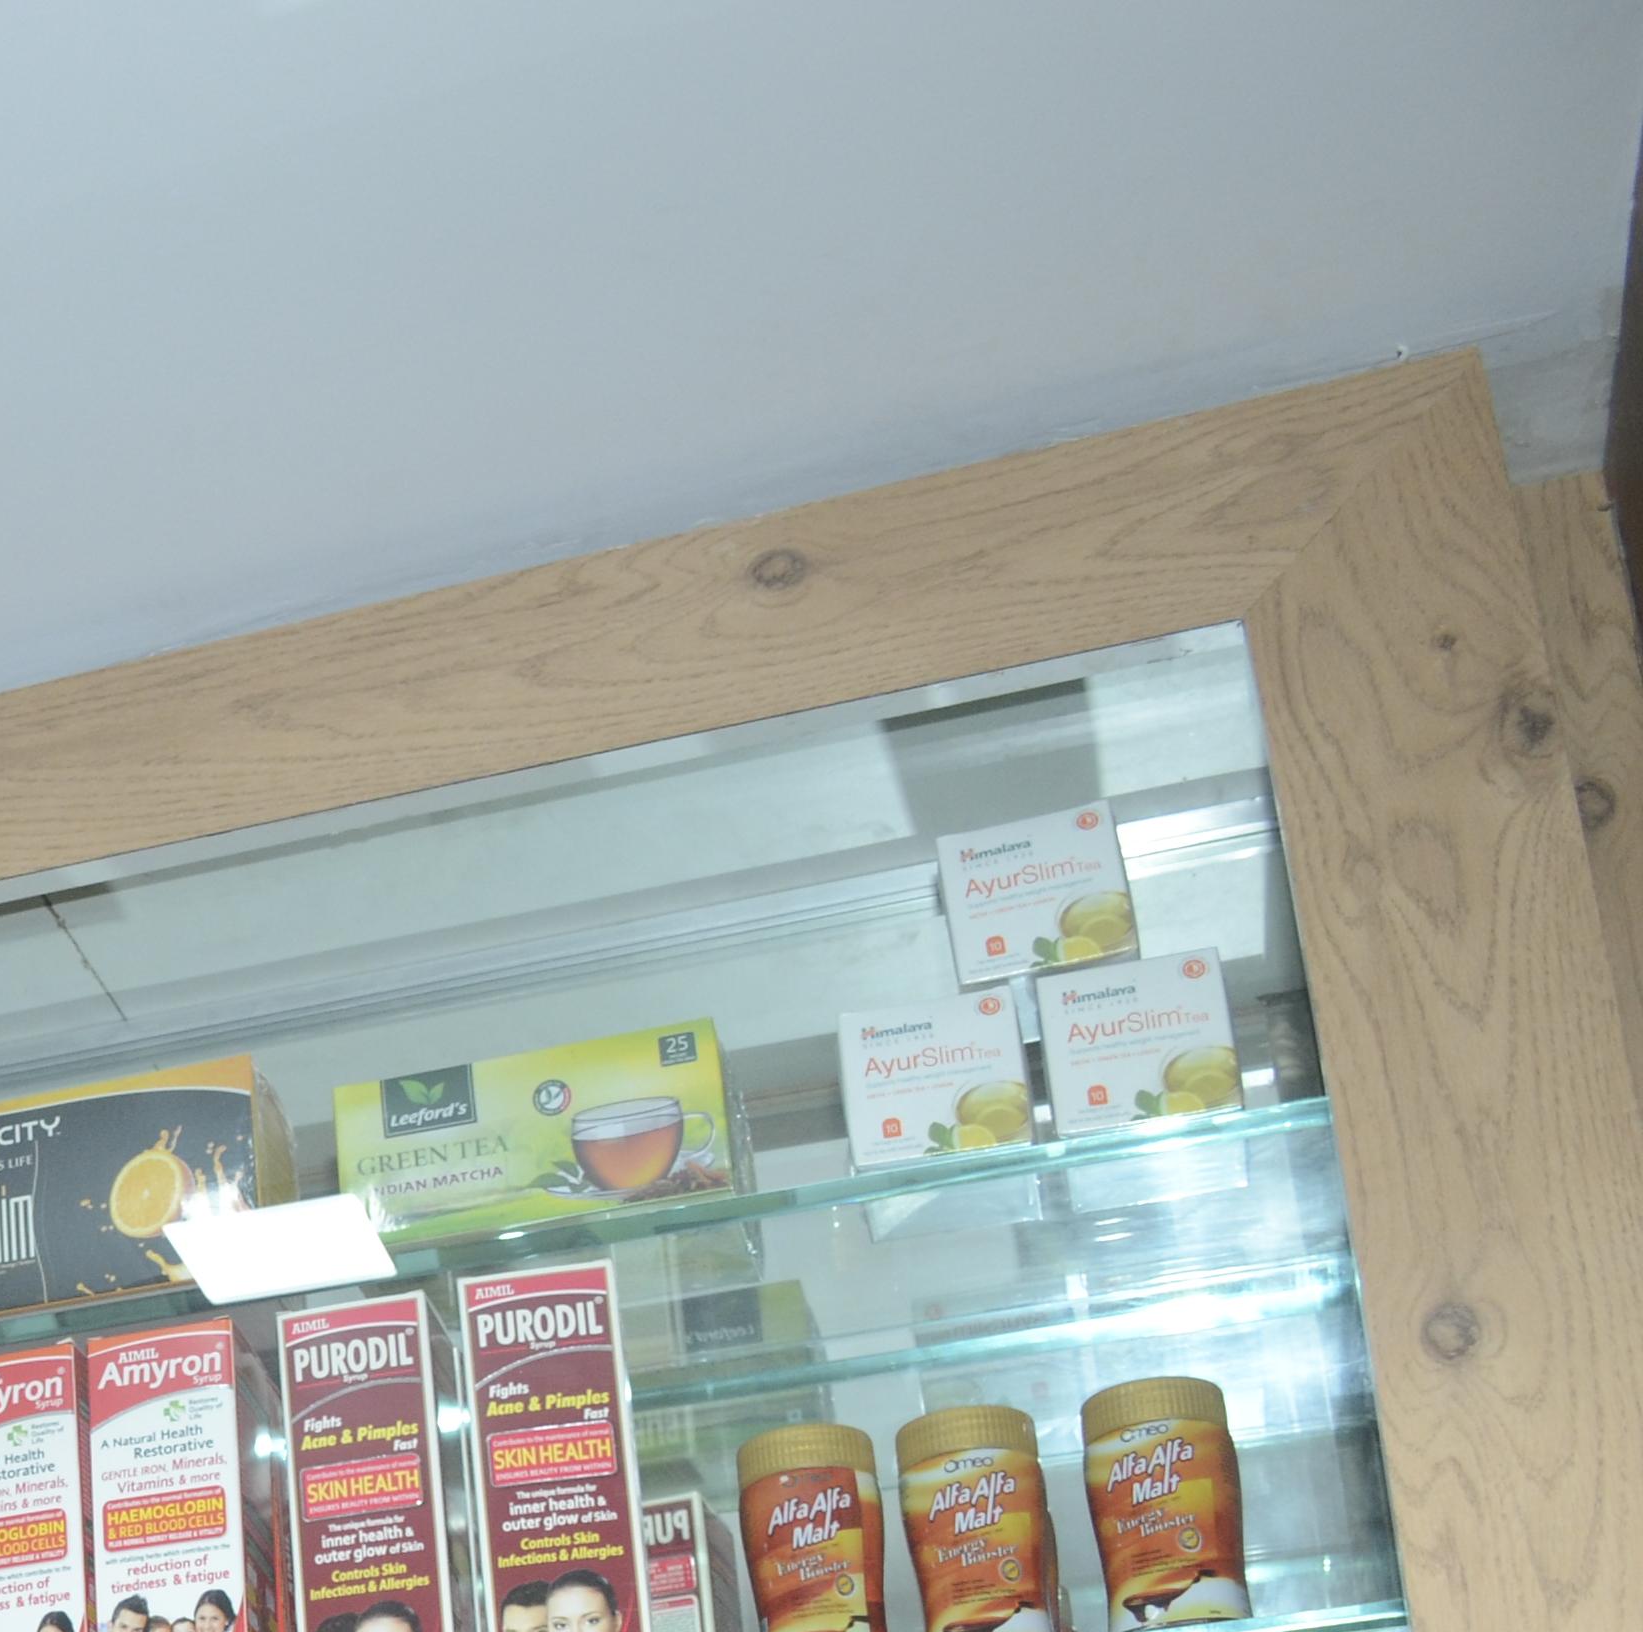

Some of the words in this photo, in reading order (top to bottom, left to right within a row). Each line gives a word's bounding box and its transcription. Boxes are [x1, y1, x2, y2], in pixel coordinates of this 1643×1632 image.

[965, 858, 1074, 899] AyurSlim
[1067, 1008, 1182, 1043] AyurSlim
[665, 1036, 689, 1052] 25
[865, 1044, 974, 1078] AyurSlim
[390, 1103, 467, 1127] Leeford's
[7, 1155, 33, 1169] LIFE
[357, 1144, 449, 1176] GREEN
[452, 1136, 509, 1157] TEA
[433, 1167, 503, 1189] MATCHA
[475, 1284, 514, 1300] AIMIL
[477, 1301, 603, 1348] PURODIL
[118, 1348, 159, 1364] AIMIL
[294, 1333, 414, 1383] PURODIL
[98, 1351, 221, 1390] Amyron
[489, 1382, 529, 1399] Fights
[487, 1401, 523, 1417] Acne
[528, 1396, 541, 1411] &
[545, 1389, 609, 1409] Pimples
[584, 1408, 609, 1420] Fast
[5, 1449, 44, 1464] Health
[493, 1447, 537, 1470] SKIN
[540, 1438, 612, 1464] HEALTH
[308, 1480, 347, 1503] SKIN
[351, 1469, 419, 1496] HEALTH
[1133, 1474, 1180, 1505] Malt
[21, 1499, 29, 1508] &
[33, 1495, 61, 1506] more
[107, 1496, 223, 1526] HAEMOGLOBIN
[509, 1502, 547, 1515] inner
[549, 1494, 595, 1510] health
[598, 1496, 606, 1506] &
[502, 1518, 541, 1532] outer
[544, 1513, 578, 1530] glow
[581, 1514, 592, 1522] of
[594, 1510, 617, 1521] Skin
[955, 1504, 1003, 1535] Malt
[31, 1535, 65, 1550] CELLS
[521, 1534, 571, 1550] Controls
[573, 1531, 599, 1544] Skin
[793, 1520, 840, 1550] Malt
[498, 1552, 557, 1568] Infections
[559, 1549, 569, 1561] &
[571, 1545, 624, 1560] Allergies
[37, 1576, 50, 1588] of
[16, 1596, 24, 1607] &
[29, 1591, 70, 1606] fatigue
